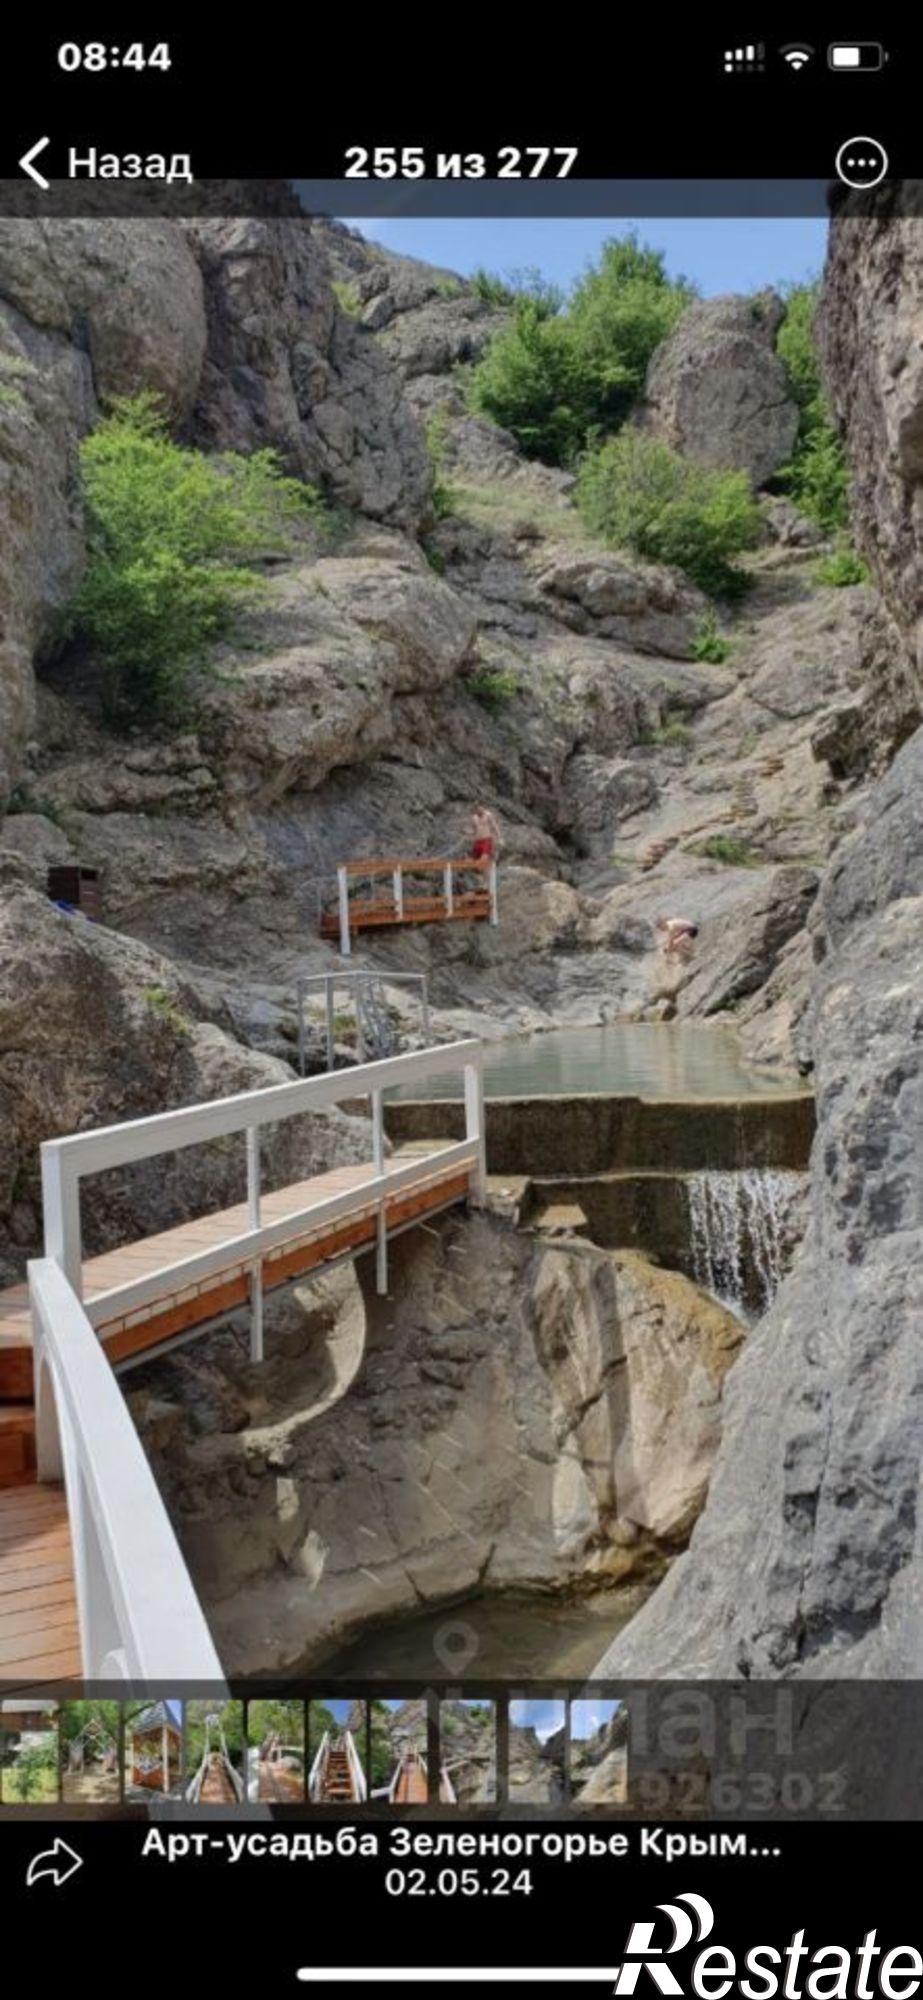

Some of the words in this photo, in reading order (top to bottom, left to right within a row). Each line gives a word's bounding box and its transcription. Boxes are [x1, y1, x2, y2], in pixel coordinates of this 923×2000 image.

[57, 42, 172, 72] 08:44
[68, 147, 194, 181] Назад
[344, 146, 426, 179] 255
[436, 153, 486, 179] из
[497, 146, 579, 178] 277
[141, 1826, 379, 1863] Арт-усадьба
[389, 1826, 629, 1863] Зеленогорье
[384, 1868, 534, 1896] 02.05.24
